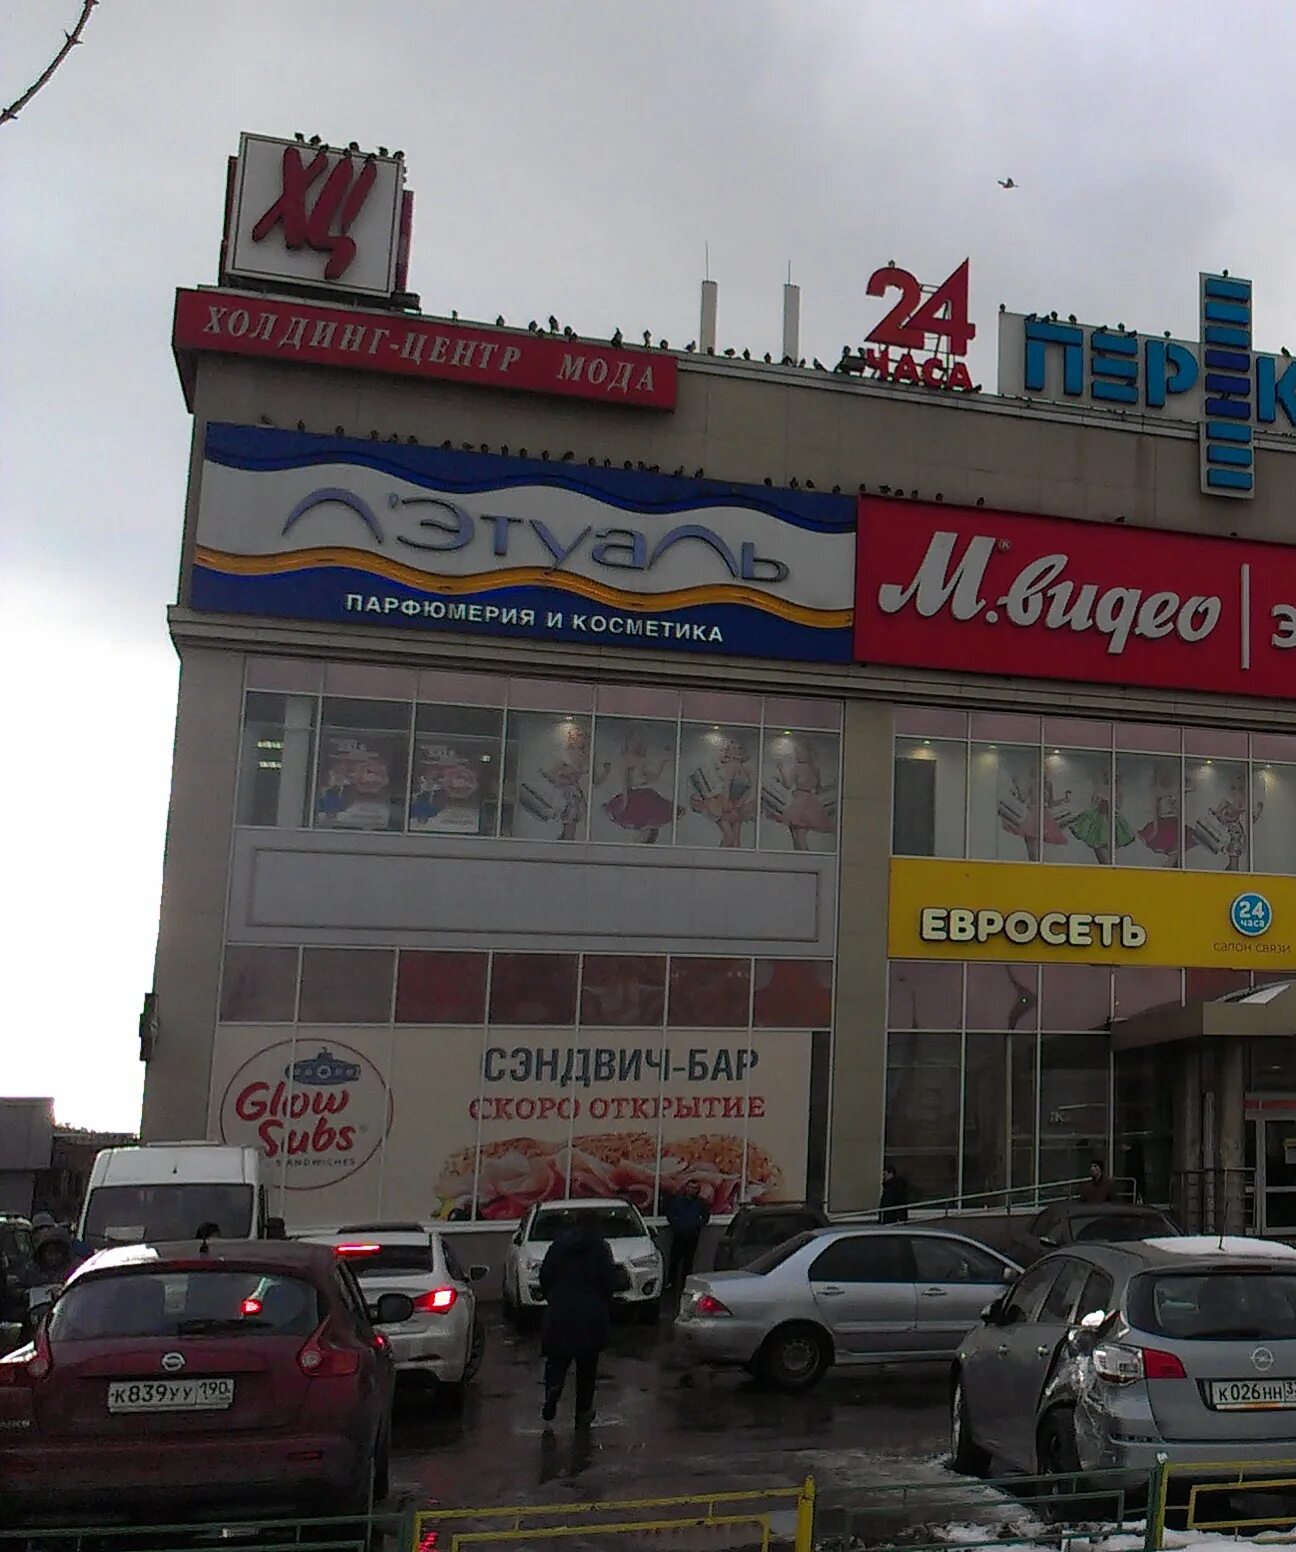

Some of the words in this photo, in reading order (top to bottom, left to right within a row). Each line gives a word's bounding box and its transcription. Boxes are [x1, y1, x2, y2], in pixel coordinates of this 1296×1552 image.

[864, 257, 976, 357] 24
[203, 304, 522, 373] ХОЛДИНГ-ЦЕНТР
[557, 352, 656, 393] МОДА
[864, 347, 973, 393] ЧАСА
[878, 531, 1222, 654] М.видео
[345, 592, 536, 628] ПАРФЮМЕРИЯ
[547, 610, 563, 629] И
[572, 614, 724, 644] КОСМЕТИКА
[921, 908, 1148, 948] ЕВРОСЕТЬ
[1239, 900, 1265, 919] 24
[1240, 919, 1265, 928] часа
[1213, 942, 1252, 953] салон
[1255, 943, 1291, 954] связи
[484, 1046, 760, 1088] СЭНДВИЧ-БАР
[235, 1080, 350, 1121] Glow
[468, 1095, 581, 1120] СКОРО
[589, 1095, 766, 1119] ОТКРЫТИЕ
[258, 1116, 356, 1157] Subs
[1219, 1383, 1282, 1401] К026НН
